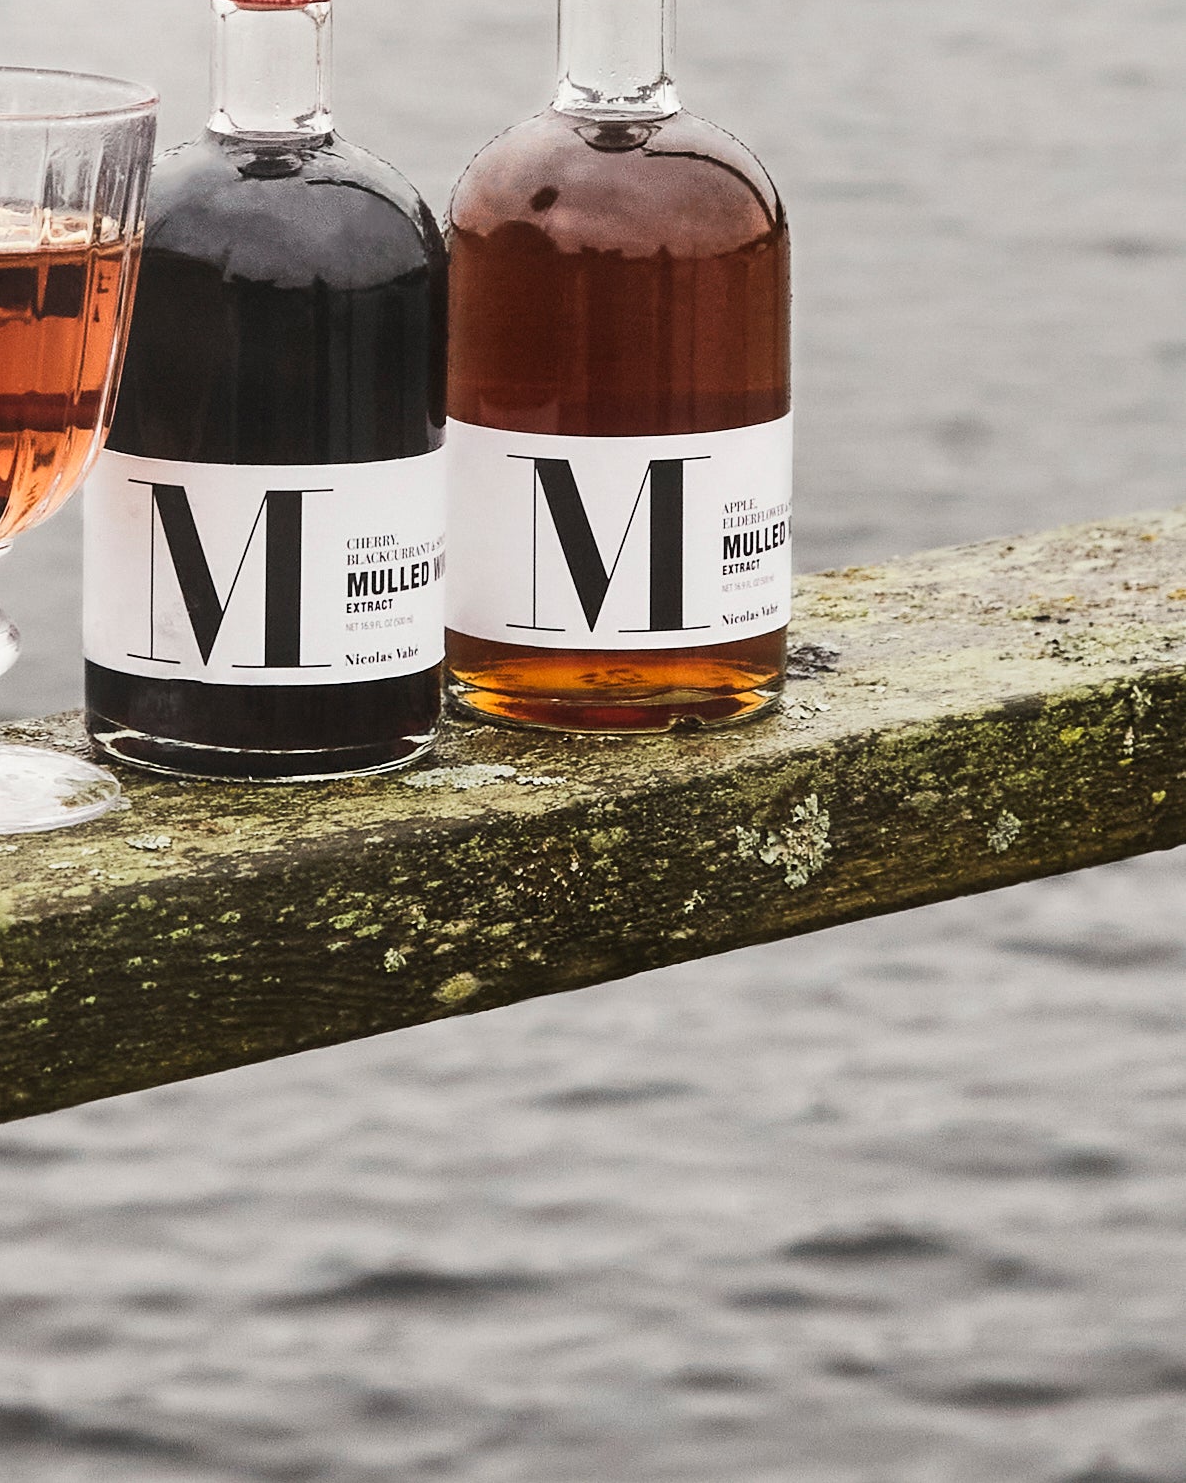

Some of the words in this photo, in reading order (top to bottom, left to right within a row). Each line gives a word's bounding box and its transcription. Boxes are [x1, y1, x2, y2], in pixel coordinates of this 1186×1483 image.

[506, 454, 712, 633] M
[723, 521, 786, 560] MULLED
[347, 542, 429, 566] BLACKCURRANT
[128, 478, 334, 668] M
[348, 561, 429, 598] MULLED
[722, 559, 760, 576] EXTRACT
[347, 599, 393, 614] EXTRACT
[722, 610, 759, 627] Nicolas
[346, 648, 392, 666] Nicolas
